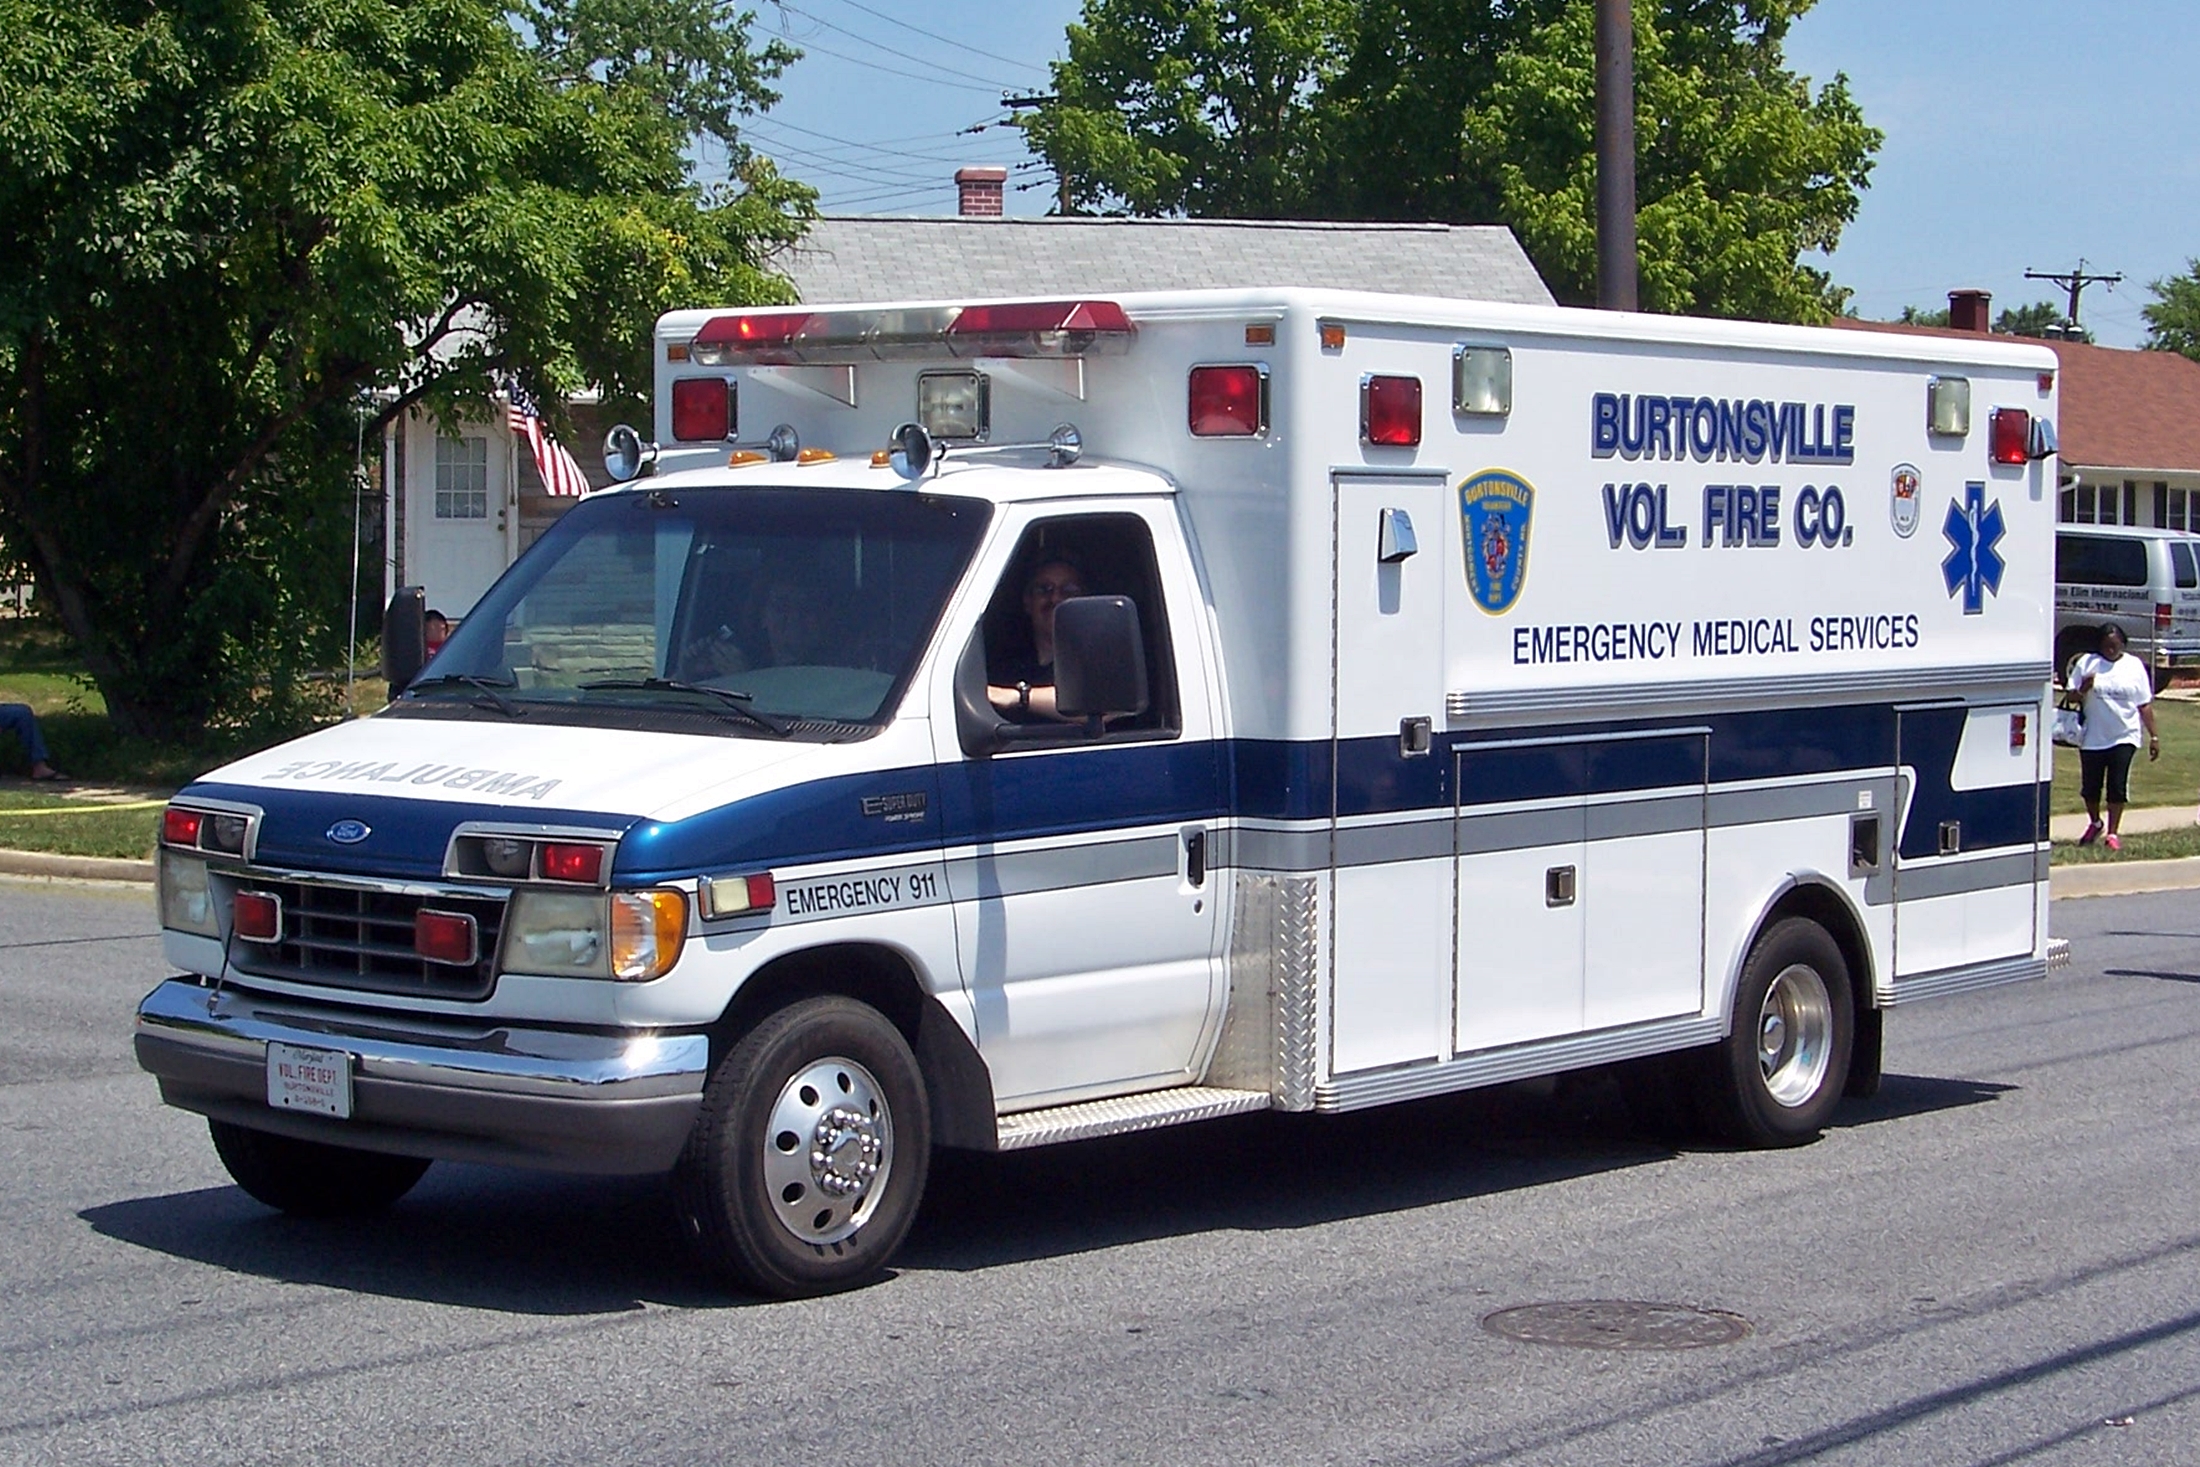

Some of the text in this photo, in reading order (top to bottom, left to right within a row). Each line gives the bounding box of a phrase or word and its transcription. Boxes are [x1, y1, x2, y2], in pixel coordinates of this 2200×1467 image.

[1592, 392, 1854, 465] BURTONSVILLE
[1465, 481, 1529, 507] BURTONSVILLE
[1602, 483, 1853, 550] VOL. FIRE CO.
[2091, 587, 2149, 600] Internacional
[1514, 614, 1919, 665] EMERGENCY MEDICAL SERVICES
[786, 872, 937, 915] EMERGENCY 911
[299, 1065, 316, 1082] FIRE
